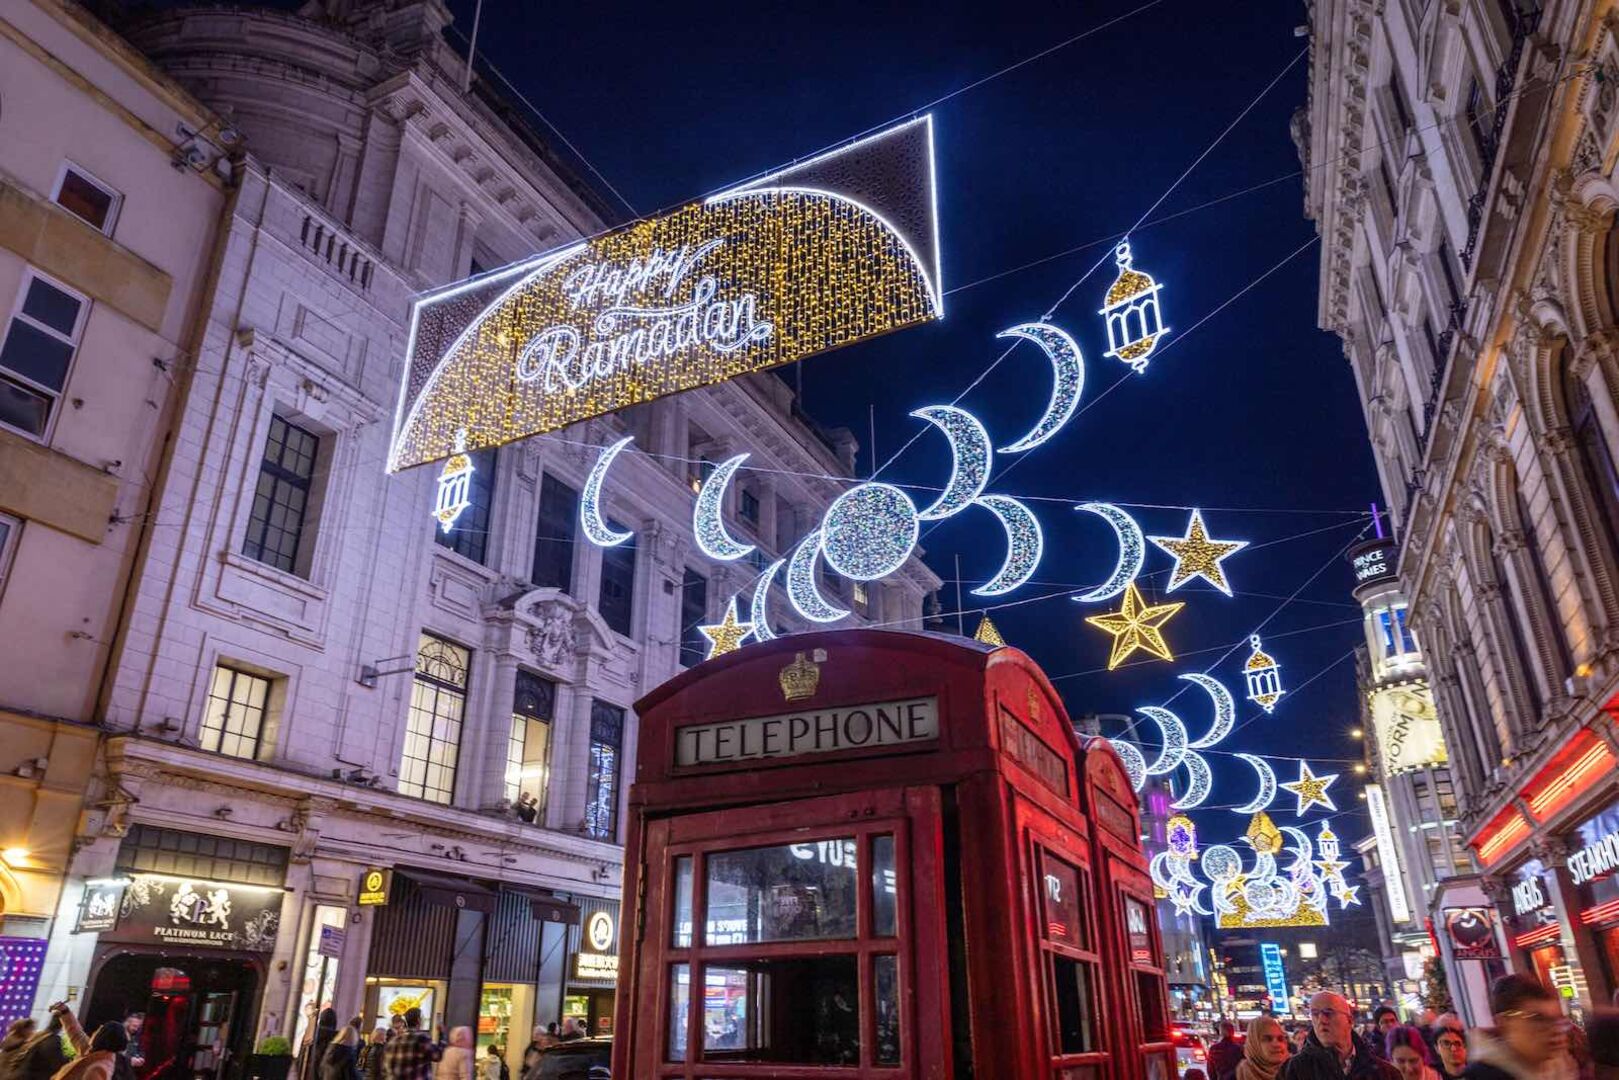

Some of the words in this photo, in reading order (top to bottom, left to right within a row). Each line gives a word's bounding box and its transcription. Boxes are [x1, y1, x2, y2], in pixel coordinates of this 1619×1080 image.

[562, 238, 724, 311] Happy
[516, 275, 774, 393] Ramadan
[1356, 563, 1387, 580] WALES
[687, 702, 929, 762] TELEPHONE
[1512, 876, 1543, 915] ANGUS
[154, 926, 208, 939] PLATINUM
[209, 932, 234, 941] LACE
